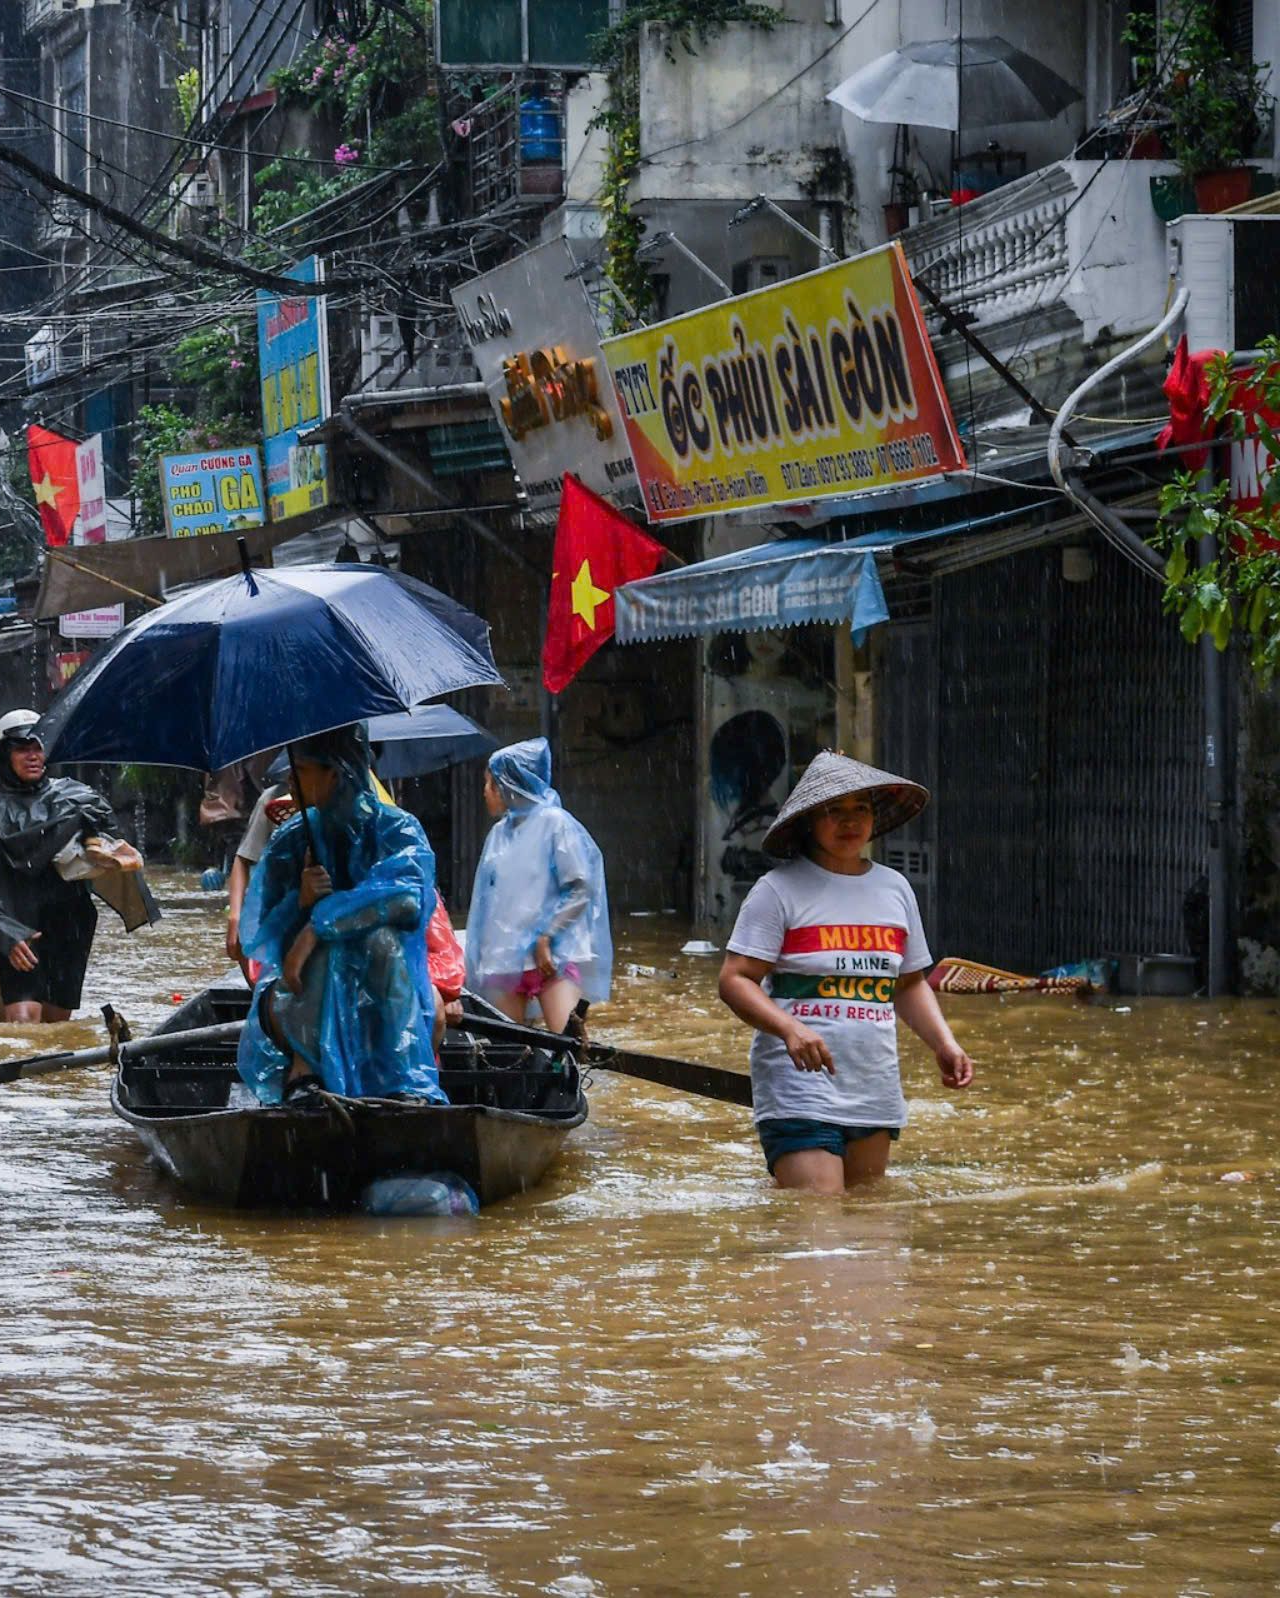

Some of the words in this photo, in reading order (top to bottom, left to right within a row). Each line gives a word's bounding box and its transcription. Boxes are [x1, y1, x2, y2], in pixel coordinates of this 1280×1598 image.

[658, 341, 712, 459] ỐC
[775, 314, 836, 437] SÀI
[830, 298, 913, 424] GÒN
[220, 468, 260, 511] GÀ
[819, 926, 897, 951] MUSIC
[836, 957, 846, 970] IS
[852, 957, 890, 970] MINE
[792, 1003, 840, 1018] SEATS
